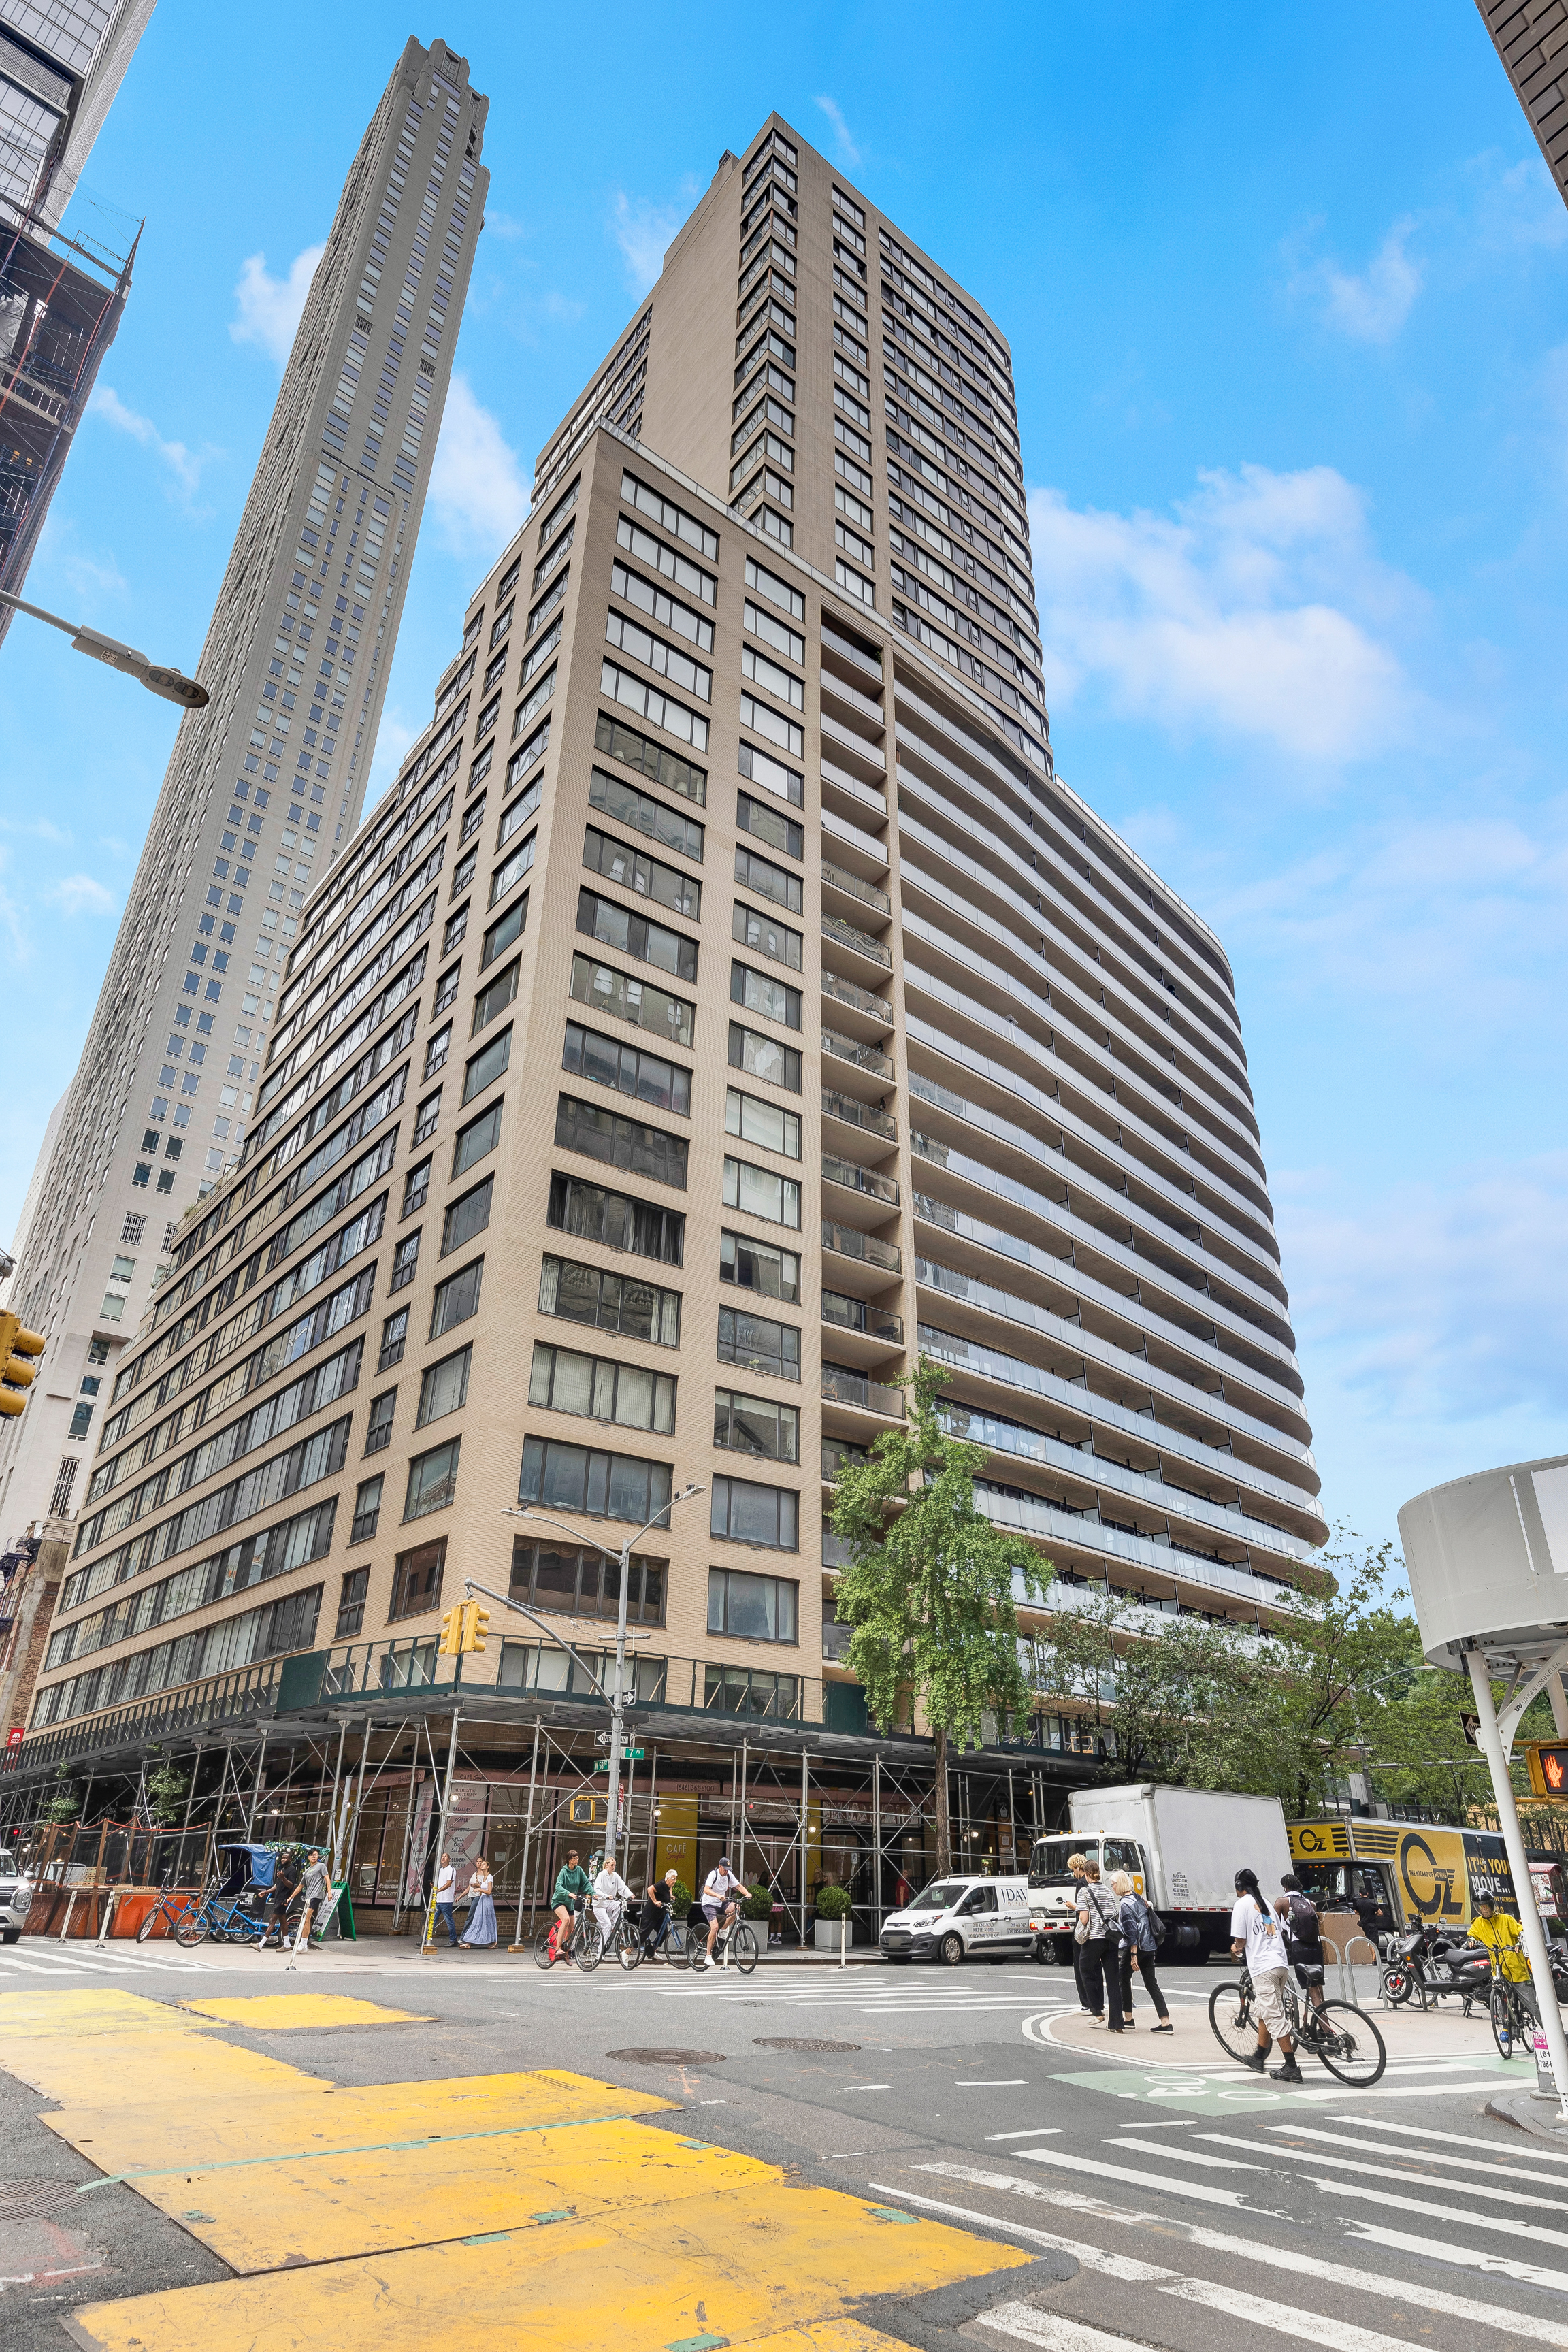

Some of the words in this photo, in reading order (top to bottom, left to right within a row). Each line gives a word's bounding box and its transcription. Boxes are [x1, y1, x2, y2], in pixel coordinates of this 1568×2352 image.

[1522, 1687, 1538, 1704] URBAN
[1536, 1661, 1560, 1688] UMBRELLA
[629, 1749, 634, 1757] 7
[1467, 1856, 1487, 1873] IT'S
